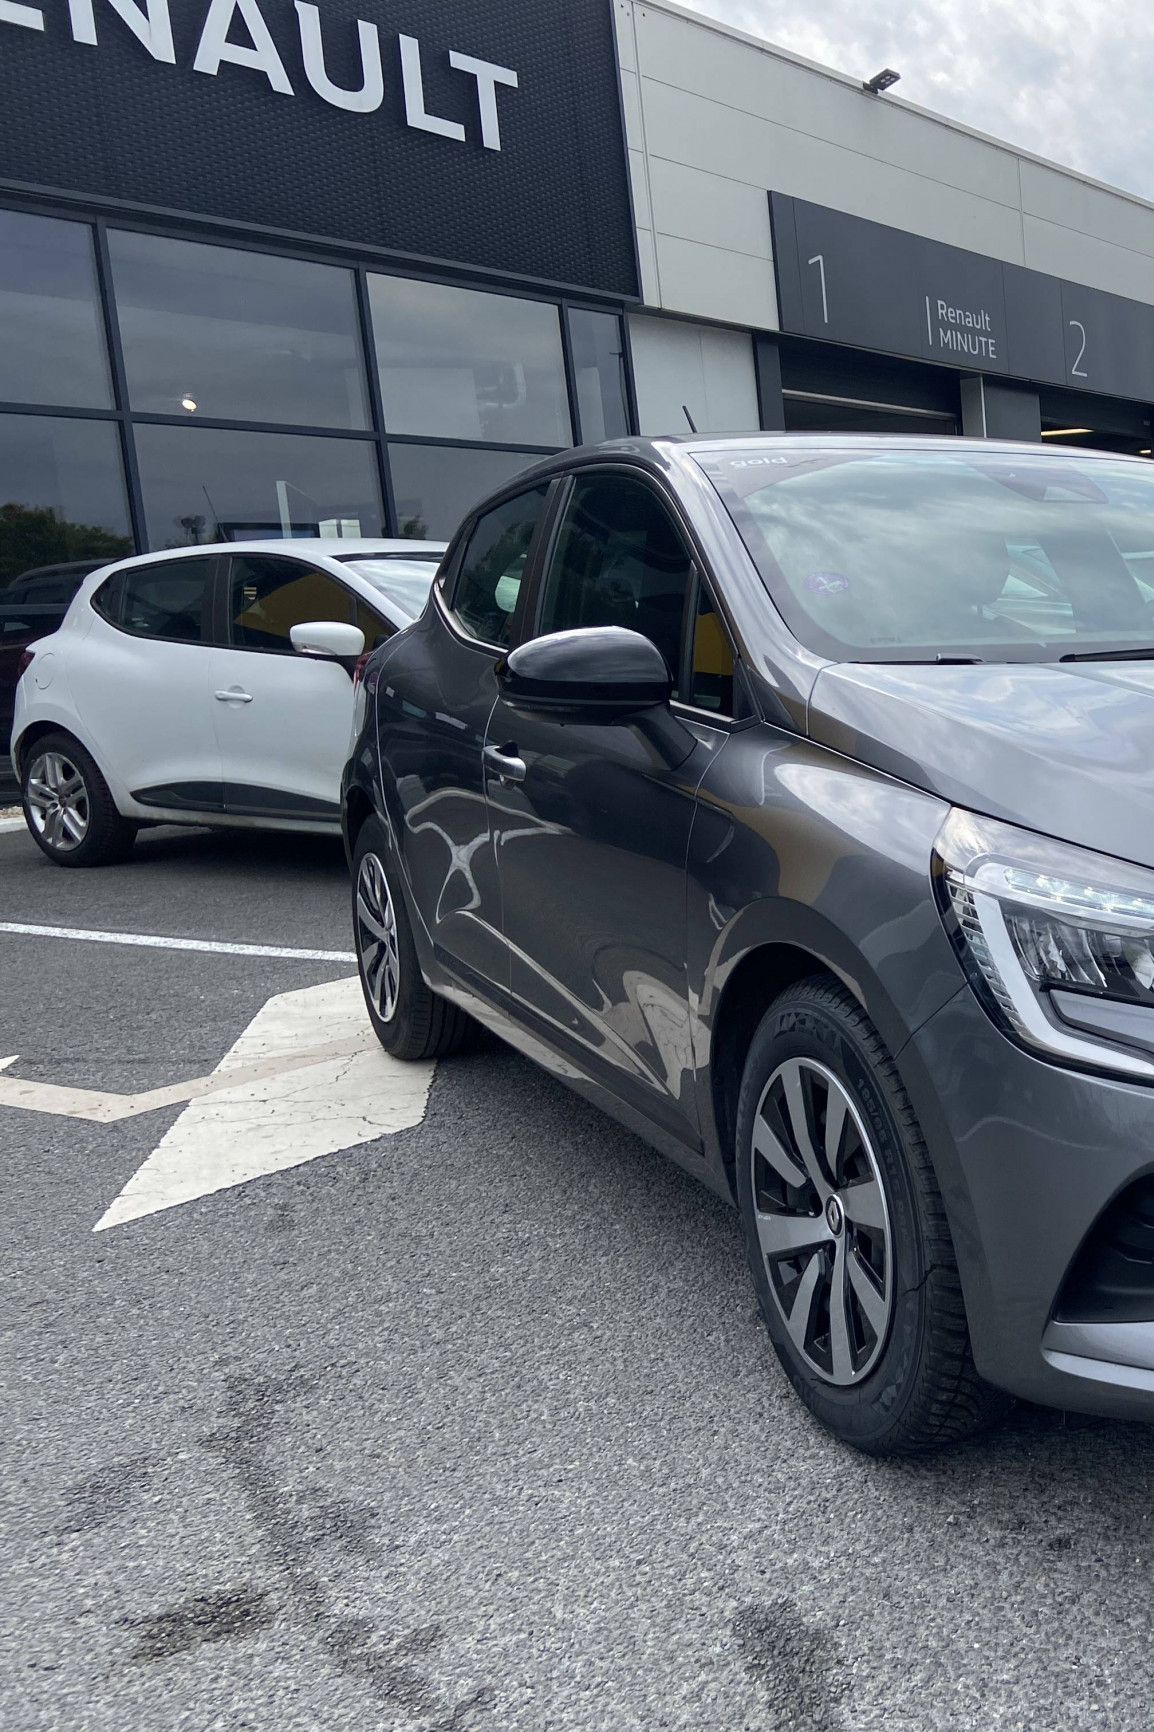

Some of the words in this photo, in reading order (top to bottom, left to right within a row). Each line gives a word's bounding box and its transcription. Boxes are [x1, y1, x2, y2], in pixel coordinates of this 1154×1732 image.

[0, 0, 519, 151] NAULT
[807, 254, 829, 323] 1
[937, 299, 992, 332] Renault
[938, 327, 997, 359] MINUTE
[1069, 320, 1088, 377] 2
[729, 456, 788, 469] gold
